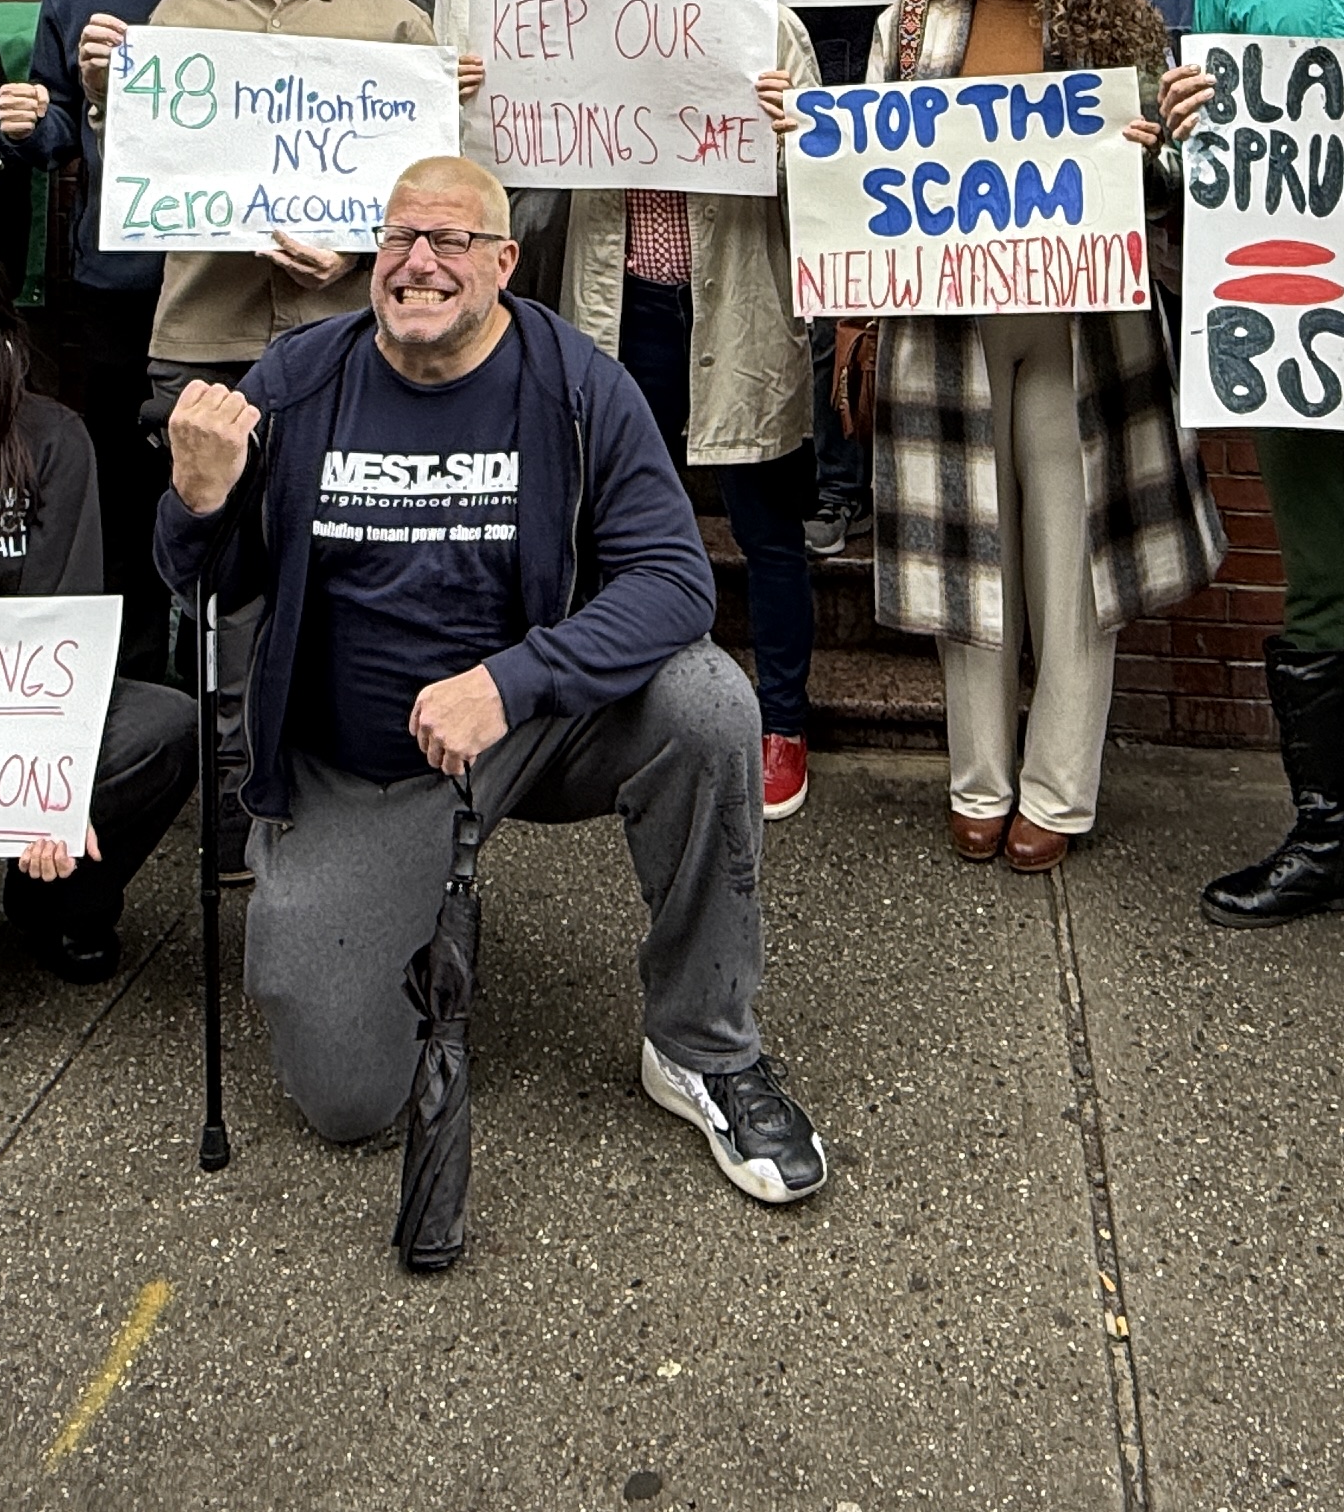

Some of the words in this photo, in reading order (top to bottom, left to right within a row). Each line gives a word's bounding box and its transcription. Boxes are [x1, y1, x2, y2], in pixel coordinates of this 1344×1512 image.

[235, 75, 353, 123] million
[357, 79, 416, 122] from
[796, 86, 949, 157] STOP
[956, 74, 1104, 142] THE
[273, 127, 358, 174] NYC
[490, 94, 658, 168] BUILDINGS
[677, 106, 759, 166] SAFE
[116, 177, 233, 231] Zero
[242, 184, 384, 224] Account
[863, 158, 1083, 236] SCAM
[797, 246, 923, 309] NIEUW
[320, 494, 451, 508] eighborhood
[459, 495, 518, 507] allian
[313, 520, 363, 541] Building
[367, 525, 409, 541] tenant
[411, 527, 446, 543] power
[449, 525, 481, 540] since
